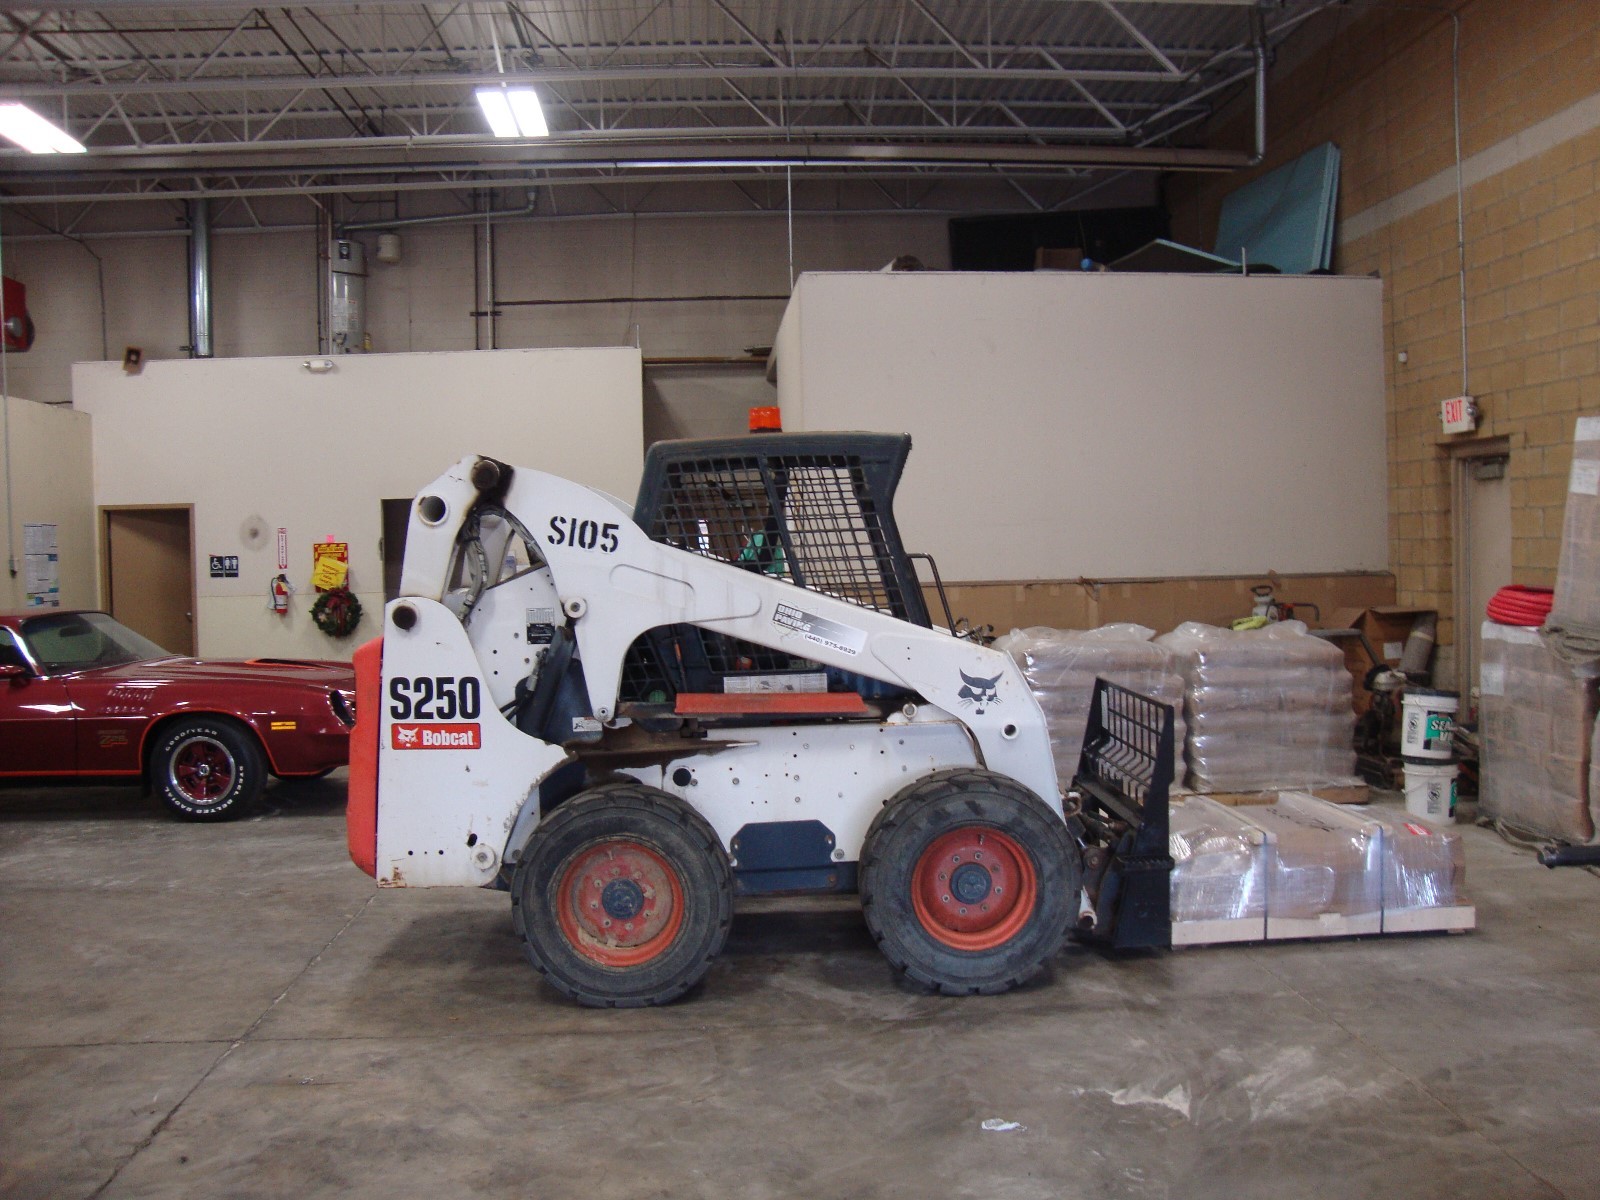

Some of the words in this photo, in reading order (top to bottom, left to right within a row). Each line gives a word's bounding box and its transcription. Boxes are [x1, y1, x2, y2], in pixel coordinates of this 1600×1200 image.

[1445, 399, 1462, 424] EXIT
[547, 515, 620, 553] S105
[774, 613, 812, 632] PAVING
[777, 604, 803, 619] OHIO
[804, 633, 823, 644] (440)
[389, 676, 481, 720] S250
[165, 727, 218, 752] GOODYEAR
[422, 729, 474, 746] Bobcat
[233, 765, 244, 796] STEEL
[164, 786, 192, 812] RADIAL
[196, 799, 233, 814] BELTED
